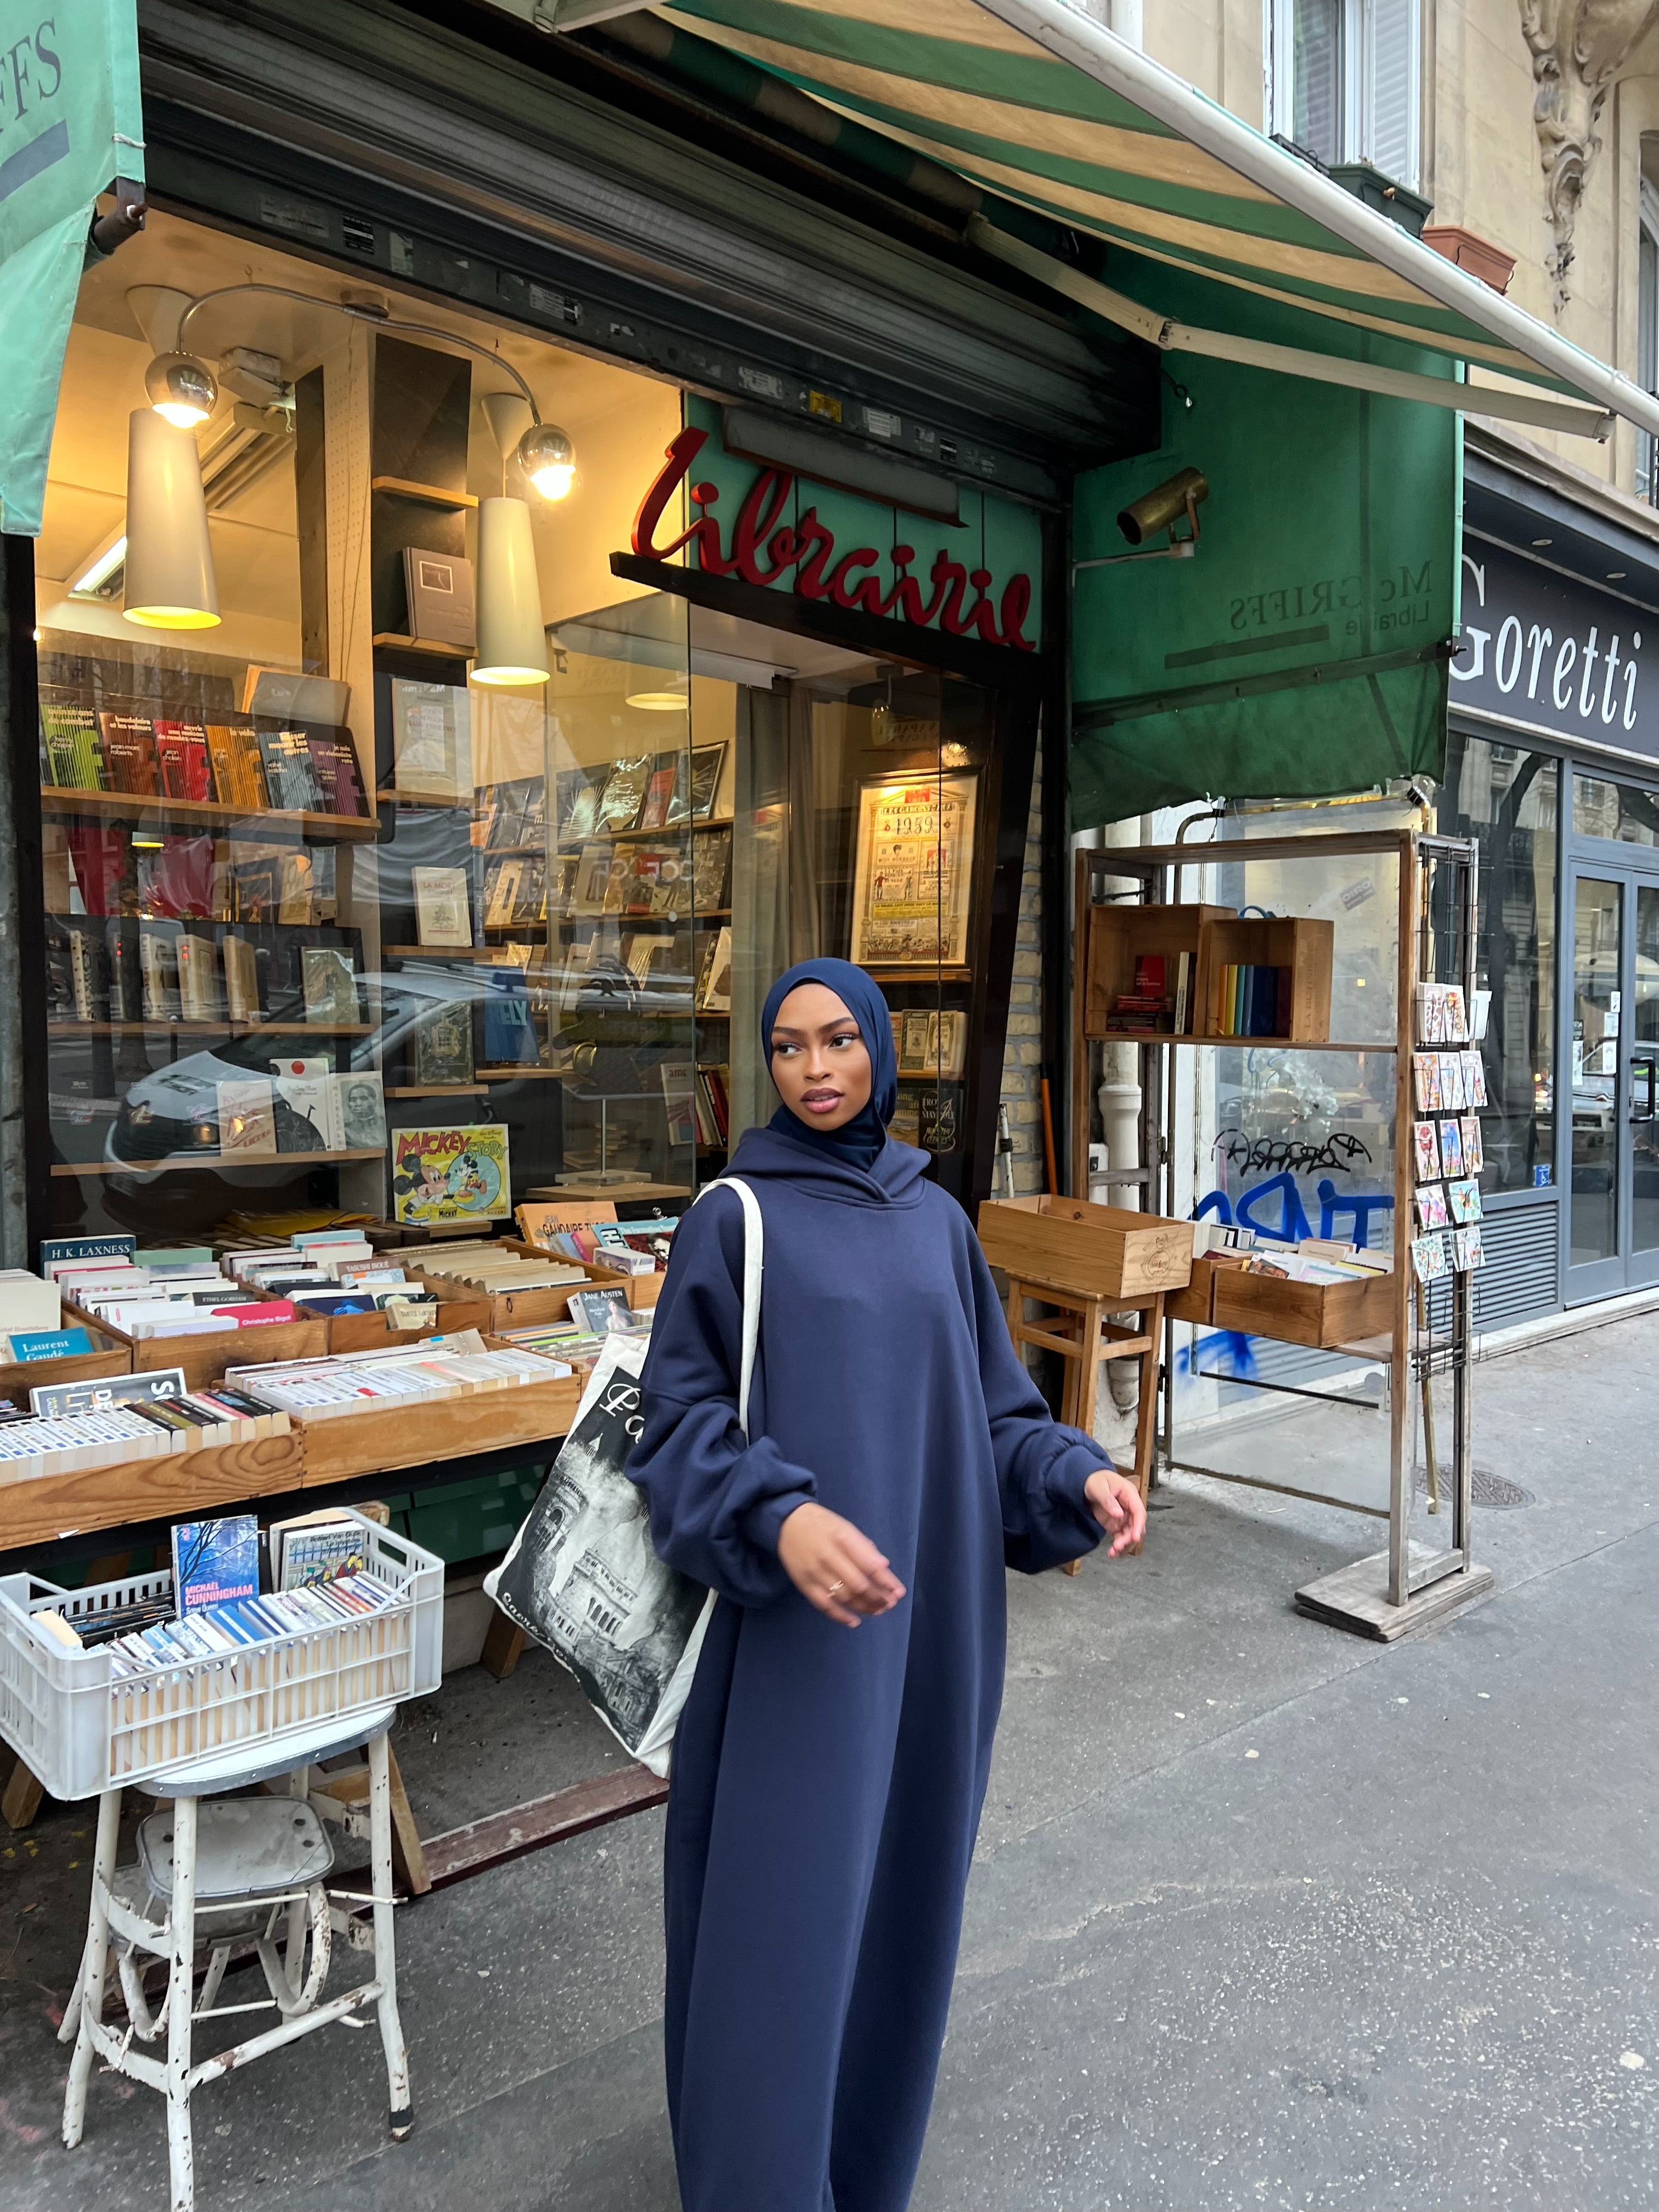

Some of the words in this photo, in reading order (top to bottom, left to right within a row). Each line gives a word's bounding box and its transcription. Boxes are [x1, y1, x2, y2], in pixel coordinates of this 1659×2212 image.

[1449, 553, 1642, 730] Goretti
[396, 1130, 472, 1166] MICKEY
[466, 1140, 509, 1160] STORY
[544, 1215, 559, 1224] JEAN
[52, 1249, 63, 1259] H.
[66, 1248, 76, 1257] K.
[79, 1244, 131, 1257] LAXNESS
[346, 1262, 371, 1273] YASUSHI
[584, 1292, 600, 1301] JANE
[600, 1290, 623, 1299] AUSTEN
[22, 1339, 70, 1353] Laurent
[26, 1349, 64, 1361] Gaudé
[185, 1582, 220, 1595] MICHAEL
[185, 1584, 253, 1606] CUNNINGHAM
